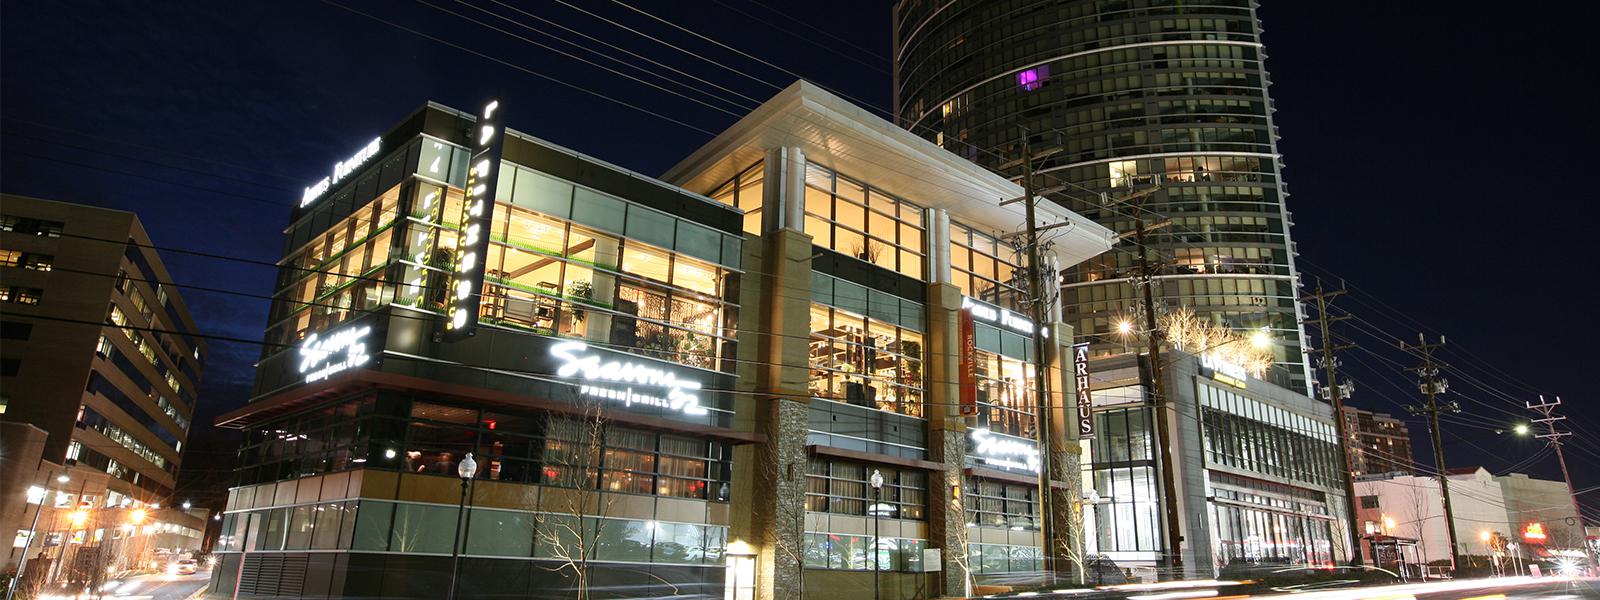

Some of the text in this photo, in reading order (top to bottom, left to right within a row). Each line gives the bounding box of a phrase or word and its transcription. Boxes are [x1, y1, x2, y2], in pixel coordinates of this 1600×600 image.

[454, 167, 477, 274] SIGNATURE
[966, 334, 975, 378] ROCKVILLE
[1075, 348, 1091, 433] ARHAUS
